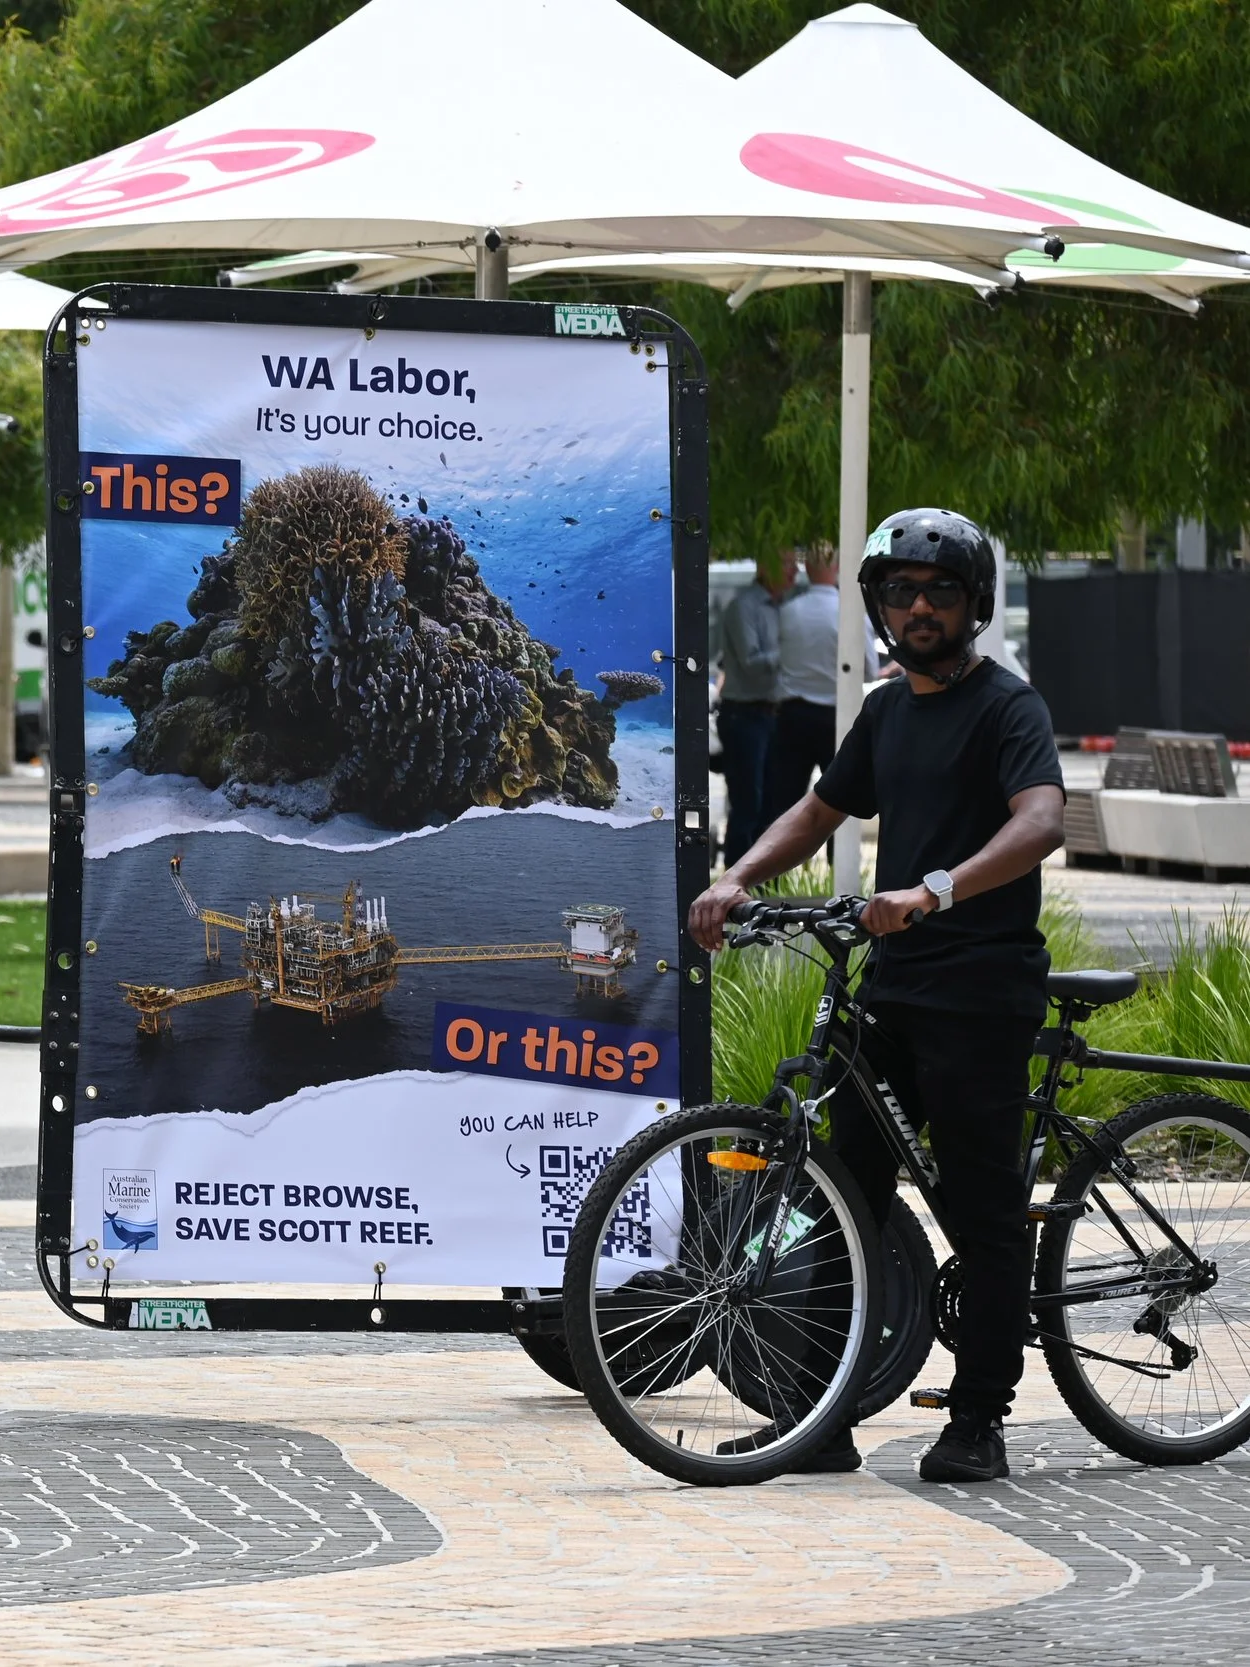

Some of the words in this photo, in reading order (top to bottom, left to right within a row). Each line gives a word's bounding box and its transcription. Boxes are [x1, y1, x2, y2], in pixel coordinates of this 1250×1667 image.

[554, 305, 618, 315] STREETFIGHTER
[554, 313, 627, 336] MEDIA
[261, 354, 335, 391] WA
[349, 357, 476, 404] Labor,
[256, 407, 296, 433] It's
[304, 414, 371, 441] your
[378, 411, 484, 442] choice.
[91, 463, 230, 515] This?
[445, 1018, 508, 1065] Or
[520, 1026, 659, 1084] this?
[459, 1116, 495, 1137] YOU
[504, 1112, 545, 1131] CAN
[553, 1111, 599, 1129] HELP
[875, 1077, 941, 1188] TOUREX
[107, 1181, 151, 1197] Marine
[110, 1174, 148, 1183] Australian
[118, 1203, 141, 1211] Society
[174, 1182, 275, 1206] REJECT
[283, 1184, 419, 1214] BROWSE,
[175, 1216, 250, 1241] SAVE
[258, 1218, 351, 1243] SCOTT
[359, 1220, 434, 1246] REEF.
[767, 1193, 789, 1249] TOUREX
[139, 1299, 206, 1308] STREETFIGHTER
[139, 1307, 212, 1330] MEDIA
